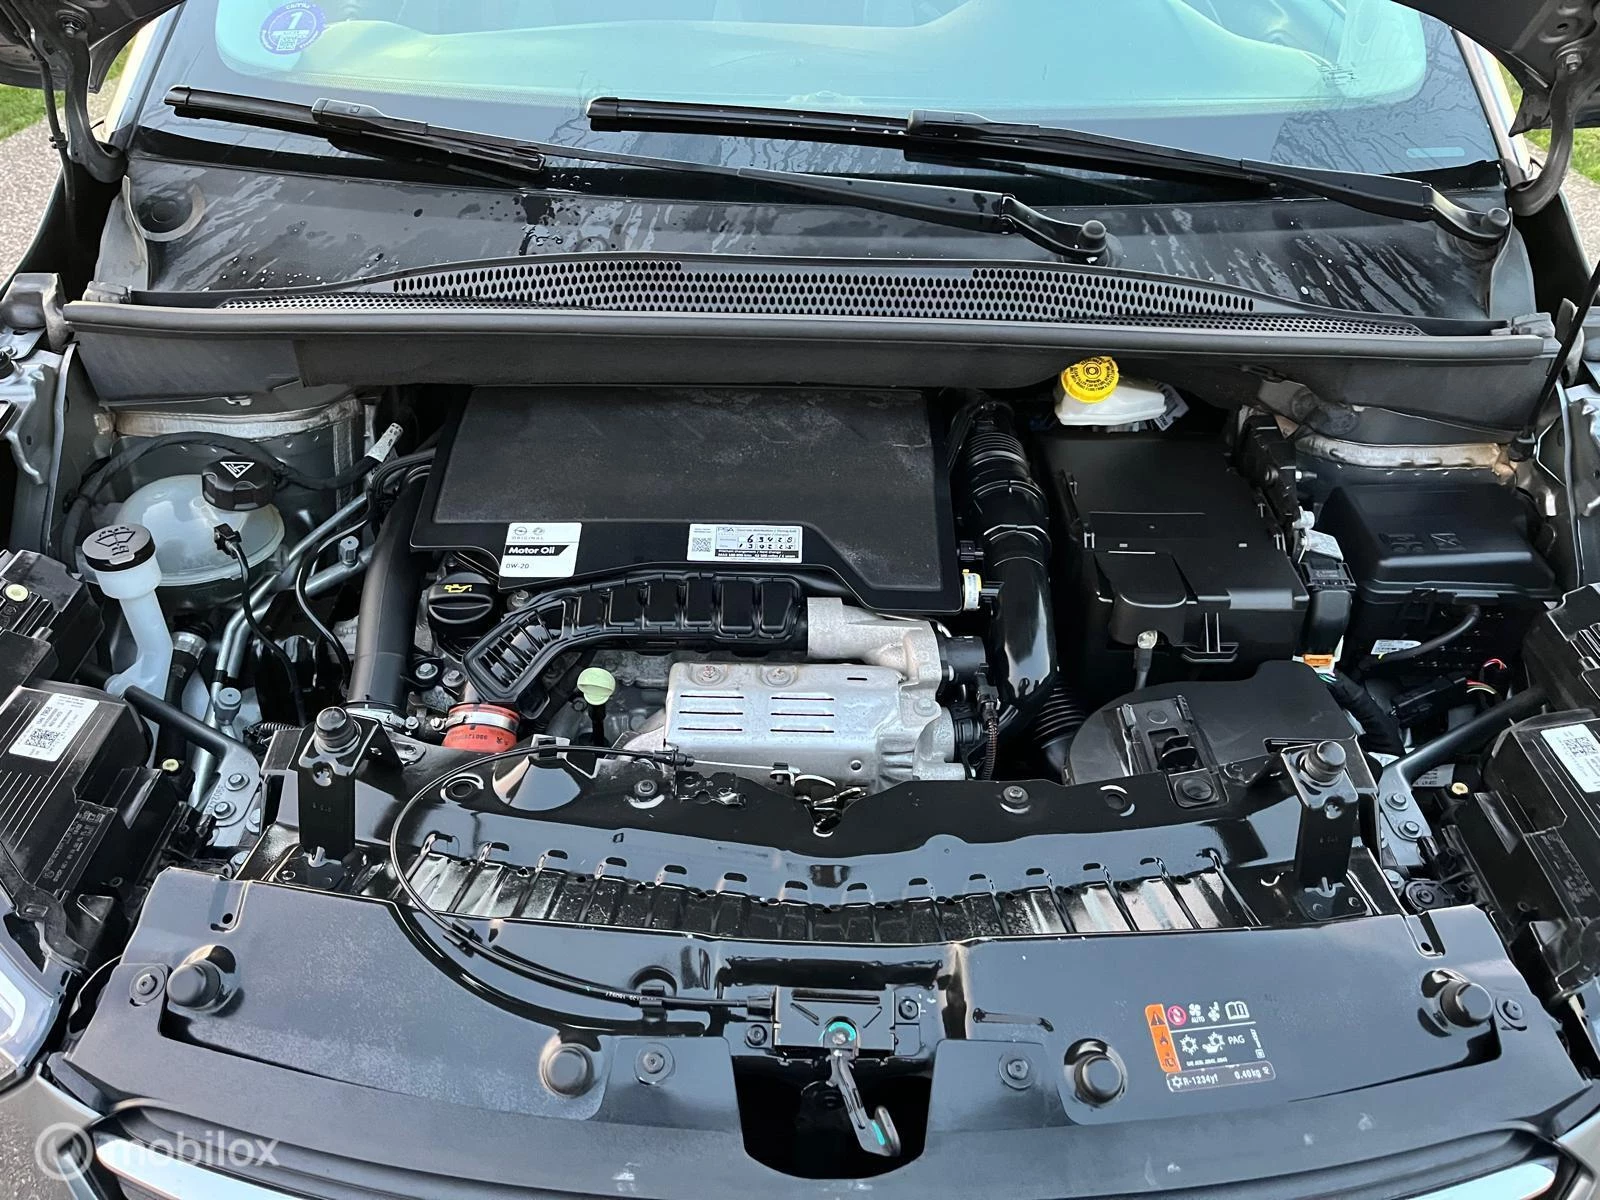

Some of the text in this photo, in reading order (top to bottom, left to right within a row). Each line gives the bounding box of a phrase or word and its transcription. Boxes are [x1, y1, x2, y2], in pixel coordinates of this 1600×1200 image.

[287, 11, 303, 29] 1
[509, 546, 555, 554] Motor Oil
[1227, 1034, 1245, 1045] PAG
